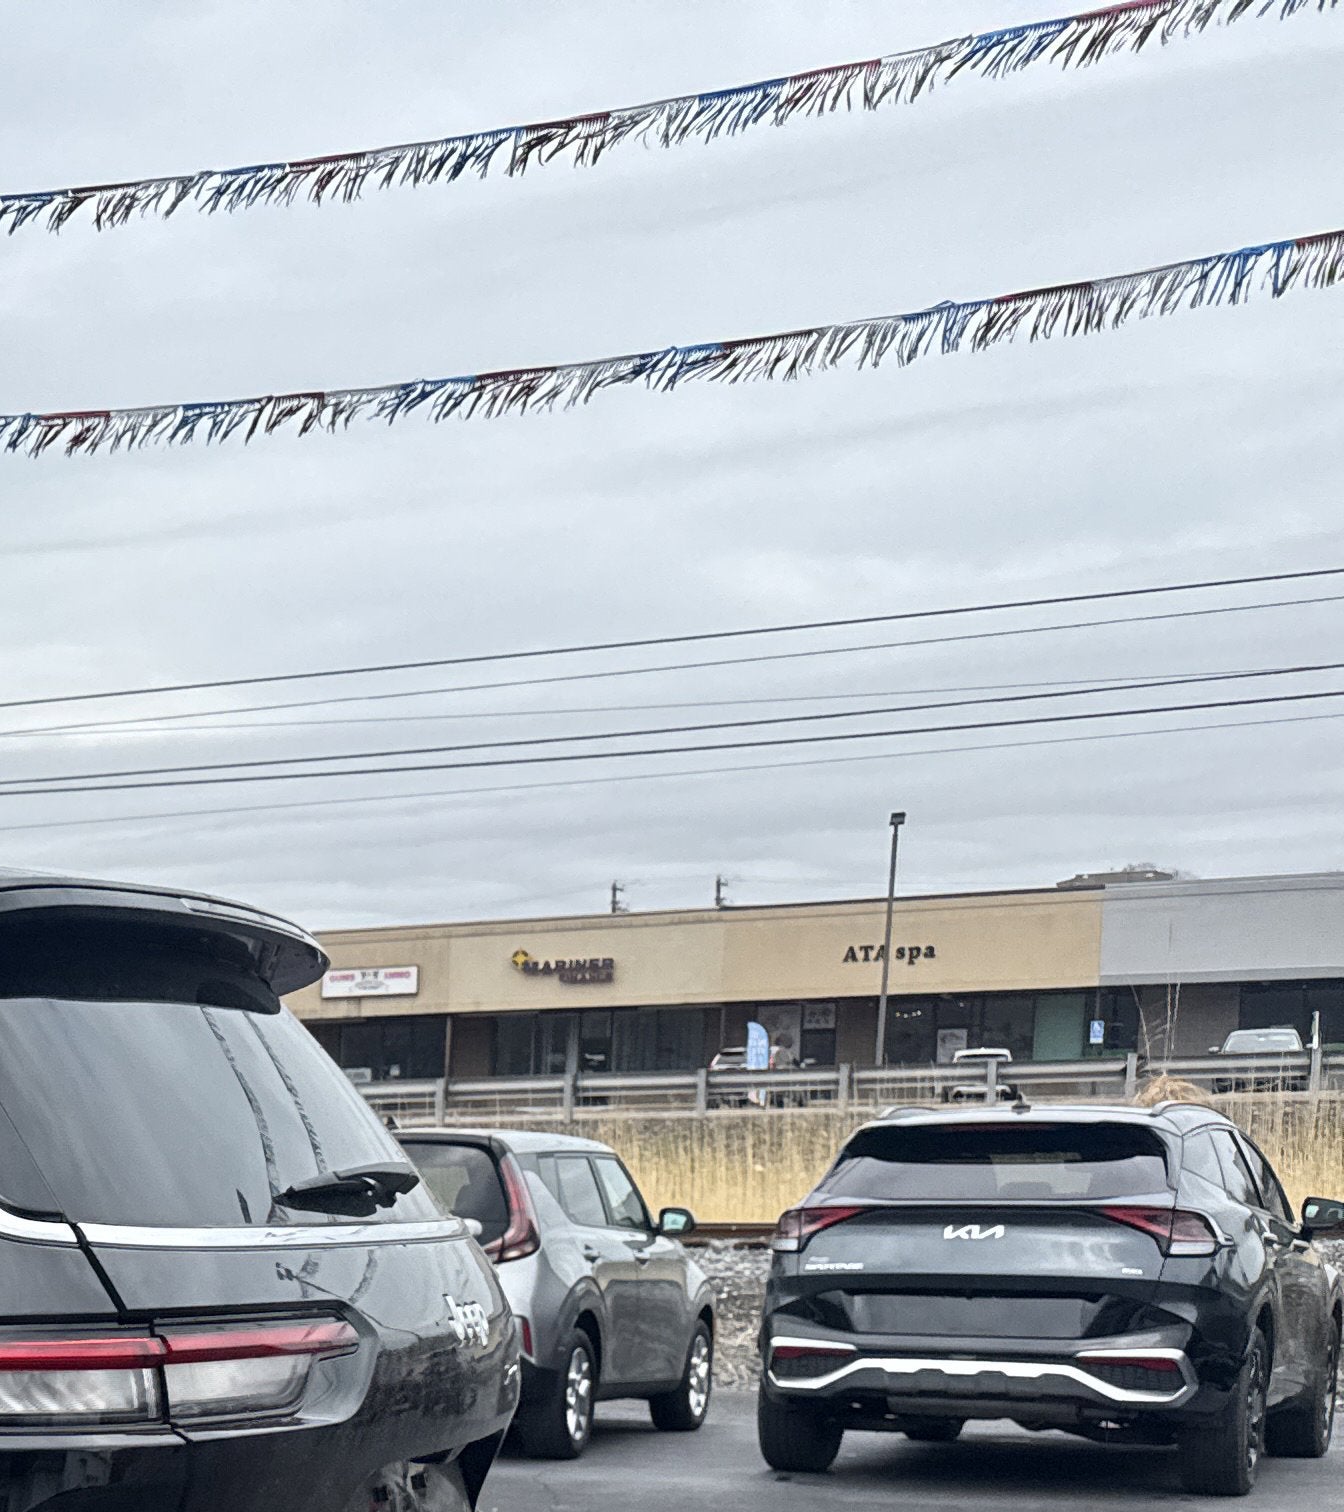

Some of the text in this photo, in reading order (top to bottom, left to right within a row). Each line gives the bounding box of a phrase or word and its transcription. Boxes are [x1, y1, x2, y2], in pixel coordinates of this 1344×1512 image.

[896, 945, 936, 966] spa
[523, 957, 615, 976] MARINER
[442, 1293, 490, 1349] Jeep
